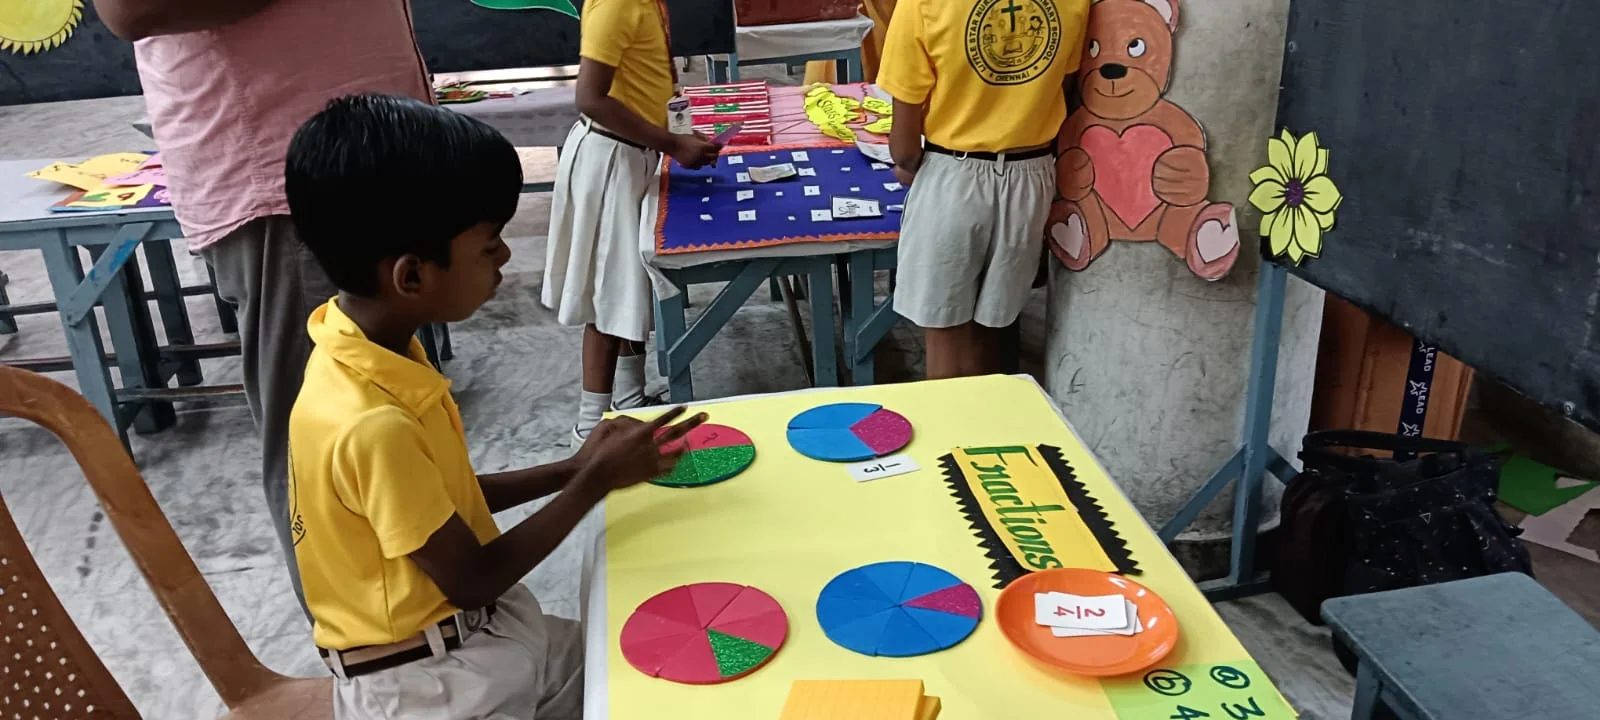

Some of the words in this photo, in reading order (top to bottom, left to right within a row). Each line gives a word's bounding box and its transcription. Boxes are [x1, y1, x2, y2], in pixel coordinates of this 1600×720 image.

[969, 19, 979, 43] STAR
[1042, 26, 1058, 61] SCHOOL
[970, 45, 986, 73] LITTLE
[995, 71, 1030, 82] CHENNAI
[1423, 347, 1436, 372] LEAD
[1415, 391, 1427, 414] LEAD
[963, 445, 1064, 569] Fractions
